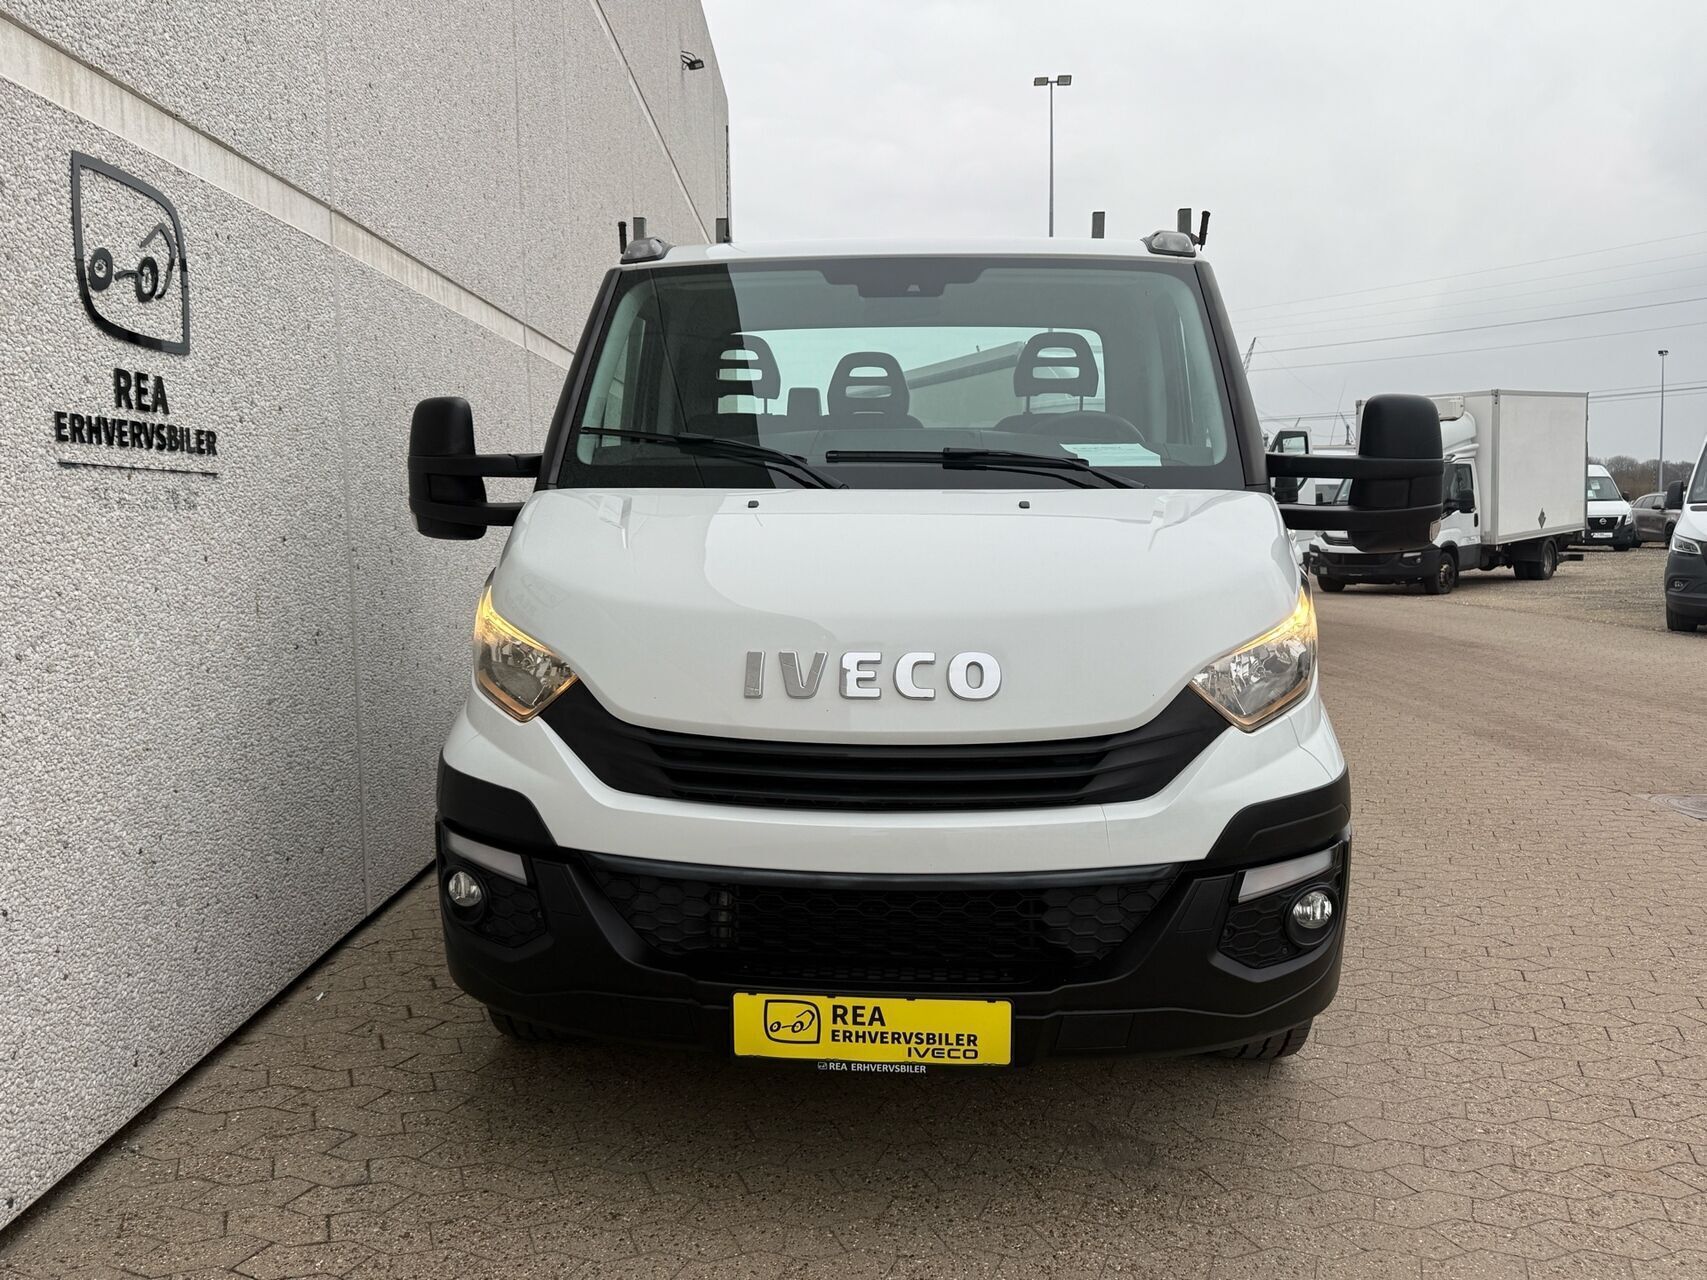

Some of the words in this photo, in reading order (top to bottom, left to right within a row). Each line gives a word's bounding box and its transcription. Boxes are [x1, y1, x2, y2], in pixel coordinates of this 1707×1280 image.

[113, 368, 170, 414] REA
[54, 411, 217, 455] ERHVERVSBILER
[744, 651, 1002, 701] IVECO
[831, 1004, 886, 1027] REA
[831, 1030, 978, 1047] ERHVERVSBILER
[907, 1047, 979, 1060] IVECO
[829, 1061, 848, 1072] REA
[851, 1062, 927, 1074] ERHVERVSBILER
